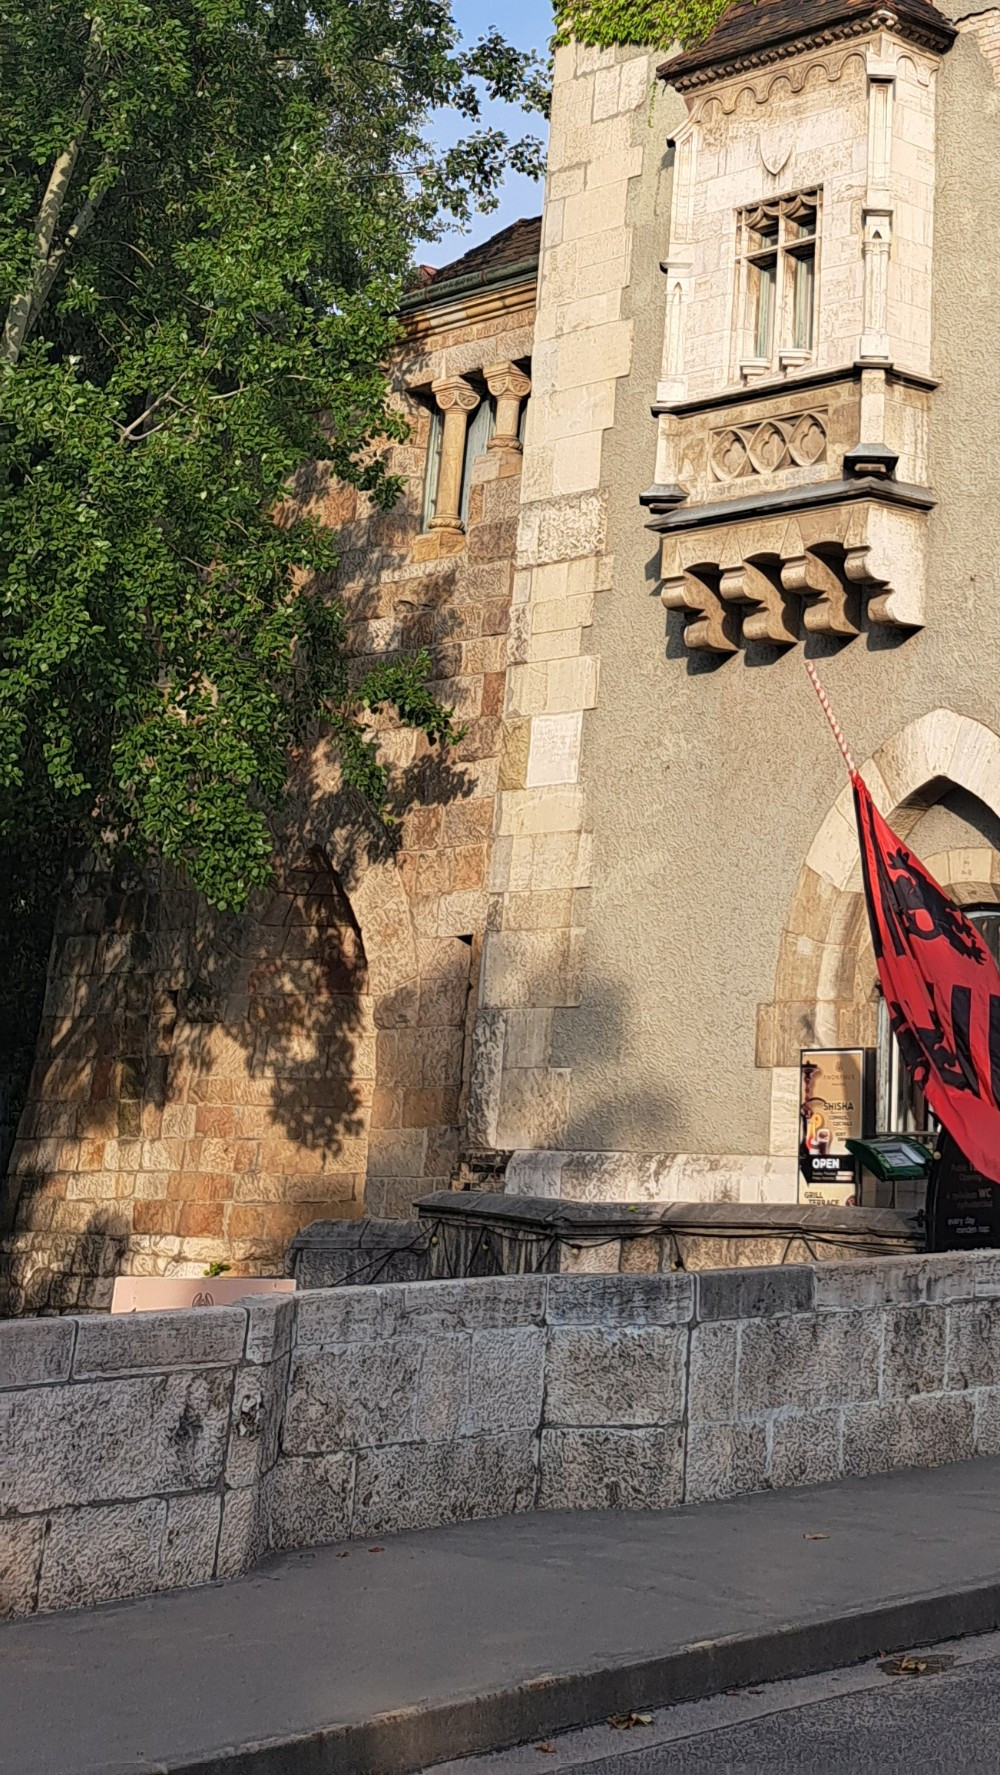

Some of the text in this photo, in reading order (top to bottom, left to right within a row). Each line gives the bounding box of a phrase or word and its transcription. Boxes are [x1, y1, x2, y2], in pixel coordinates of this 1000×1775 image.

[823, 1102, 854, 1111] SHISHA
[812, 1158, 840, 1169] OPEN
[804, 1191, 823, 1199] GRILL
